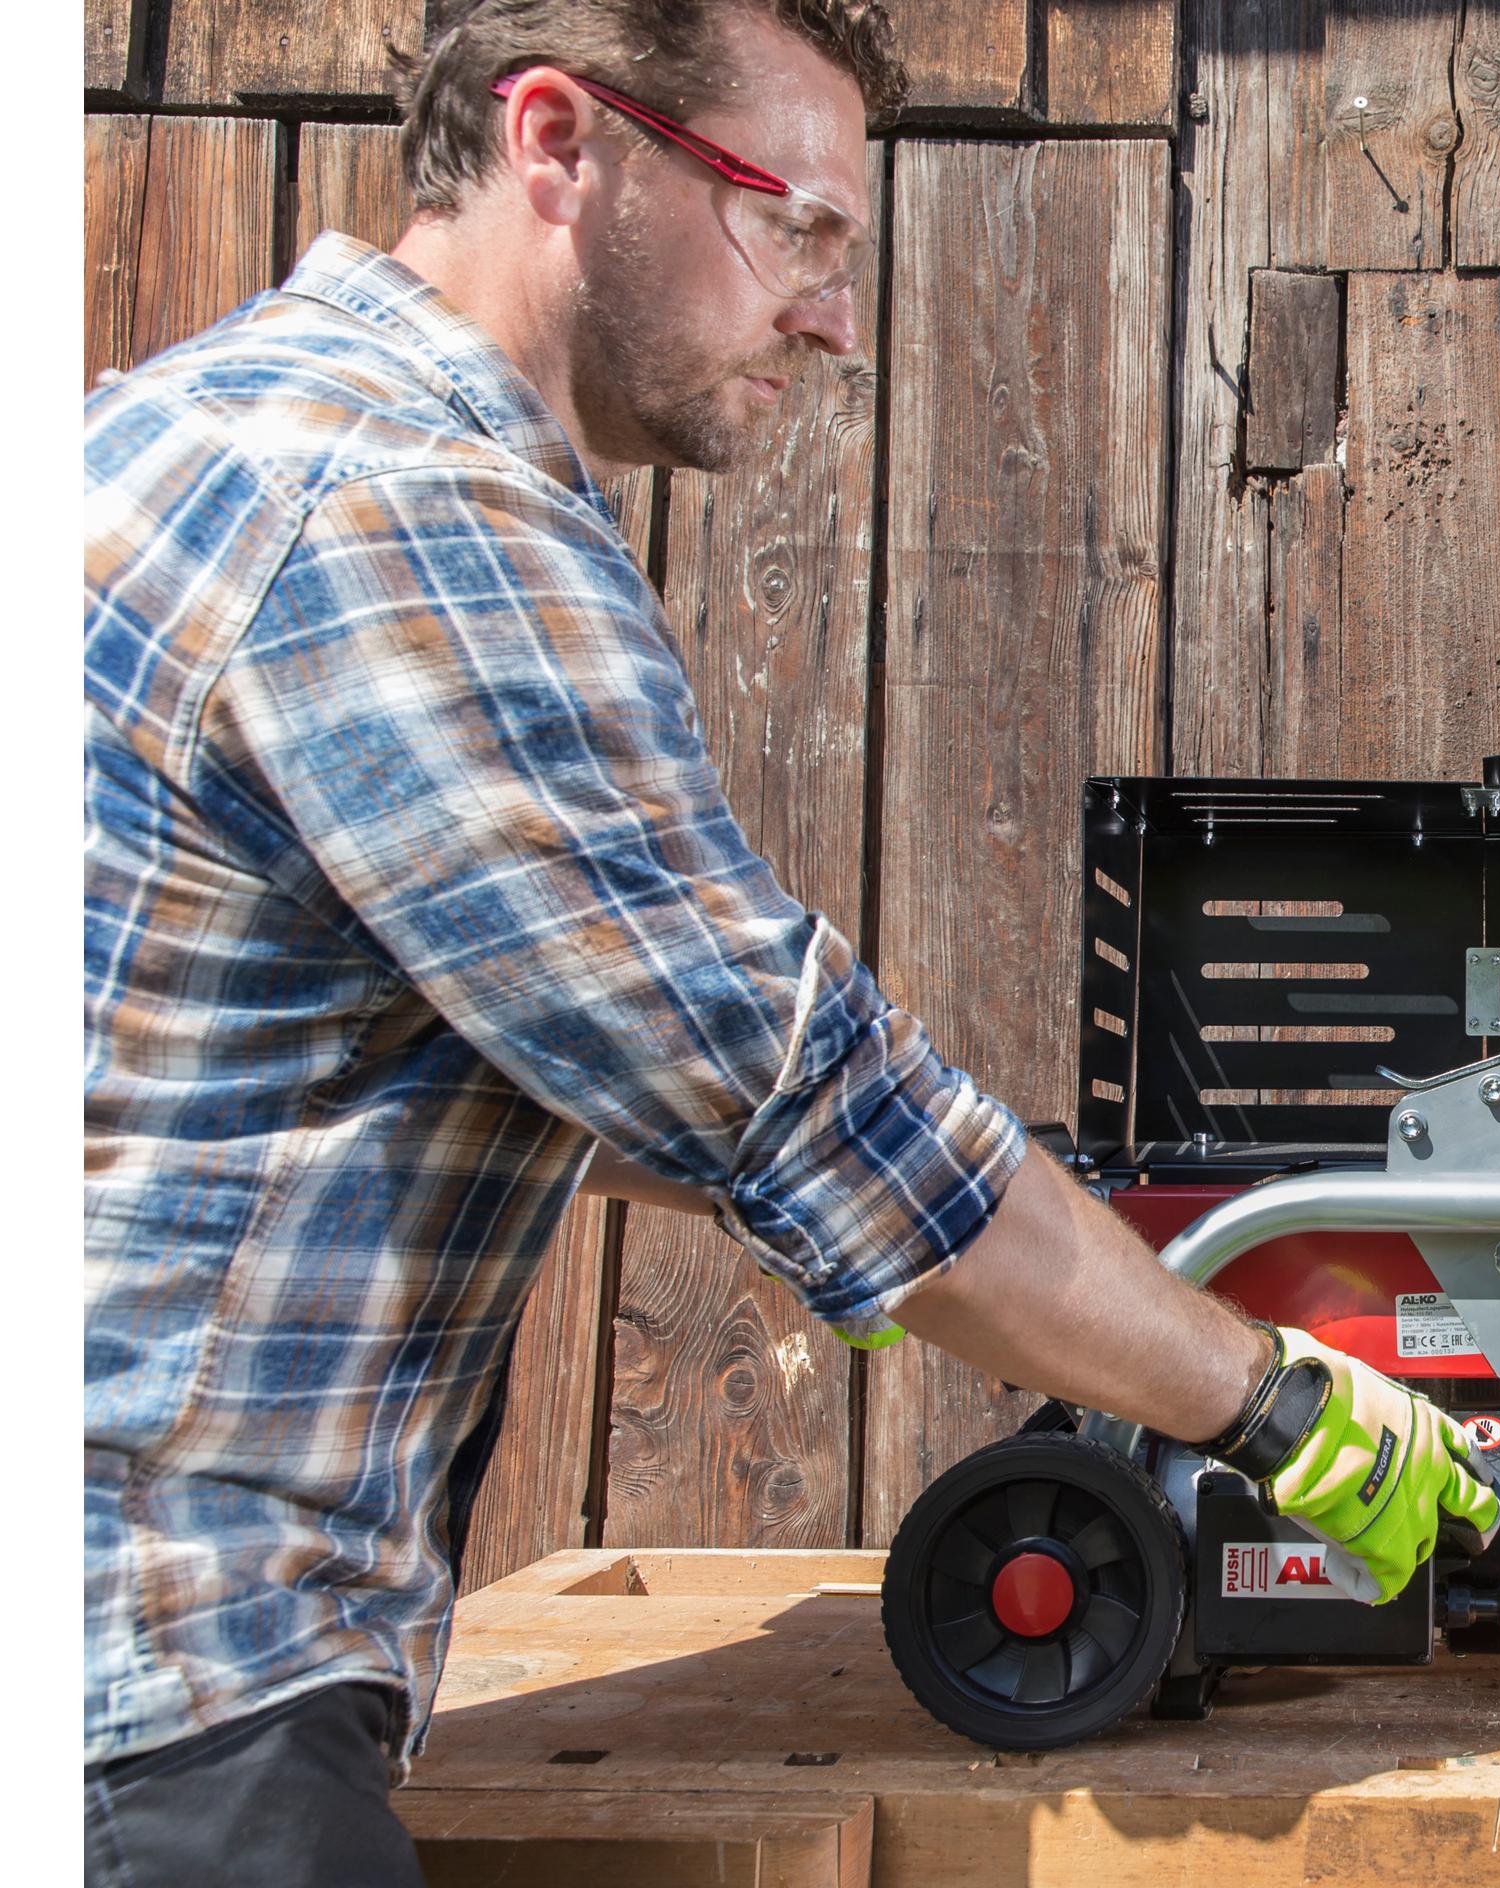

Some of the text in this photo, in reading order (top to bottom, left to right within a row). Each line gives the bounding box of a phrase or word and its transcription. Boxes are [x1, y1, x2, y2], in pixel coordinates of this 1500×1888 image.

[1401, 1295, 1437, 1305] AL-KO
[1226, 1548, 1239, 1592] PUSH
[1275, 1556, 1333, 1585] AL
